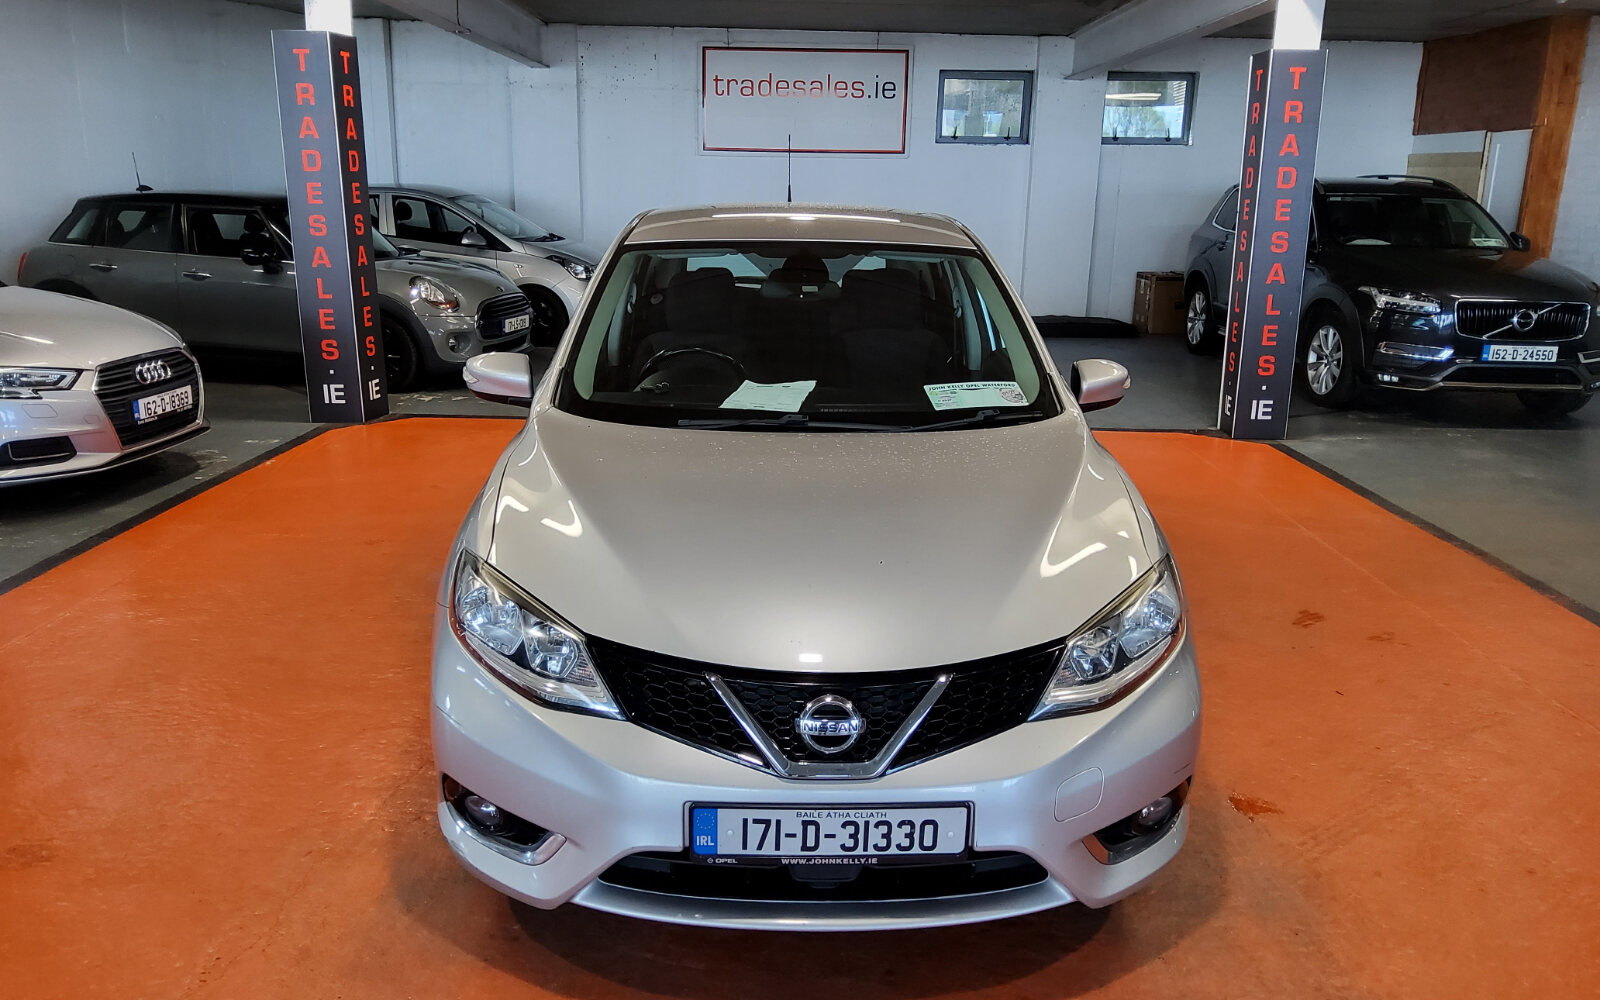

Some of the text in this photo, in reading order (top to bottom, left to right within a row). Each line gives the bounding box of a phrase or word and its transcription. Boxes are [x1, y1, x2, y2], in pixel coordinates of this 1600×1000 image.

[713, 72, 897, 99] tradesales.ie
[1491, 348, 1554, 361] 152-D-24550
[143, 390, 189, 417] 162-D-18369
[803, 722, 859, 734] NISSAN
[696, 835, 715, 846] IRL
[741, 818, 939, 852] 171-D-31330
[781, 857, 878, 865] WWW.JOHNKELLY.IE
